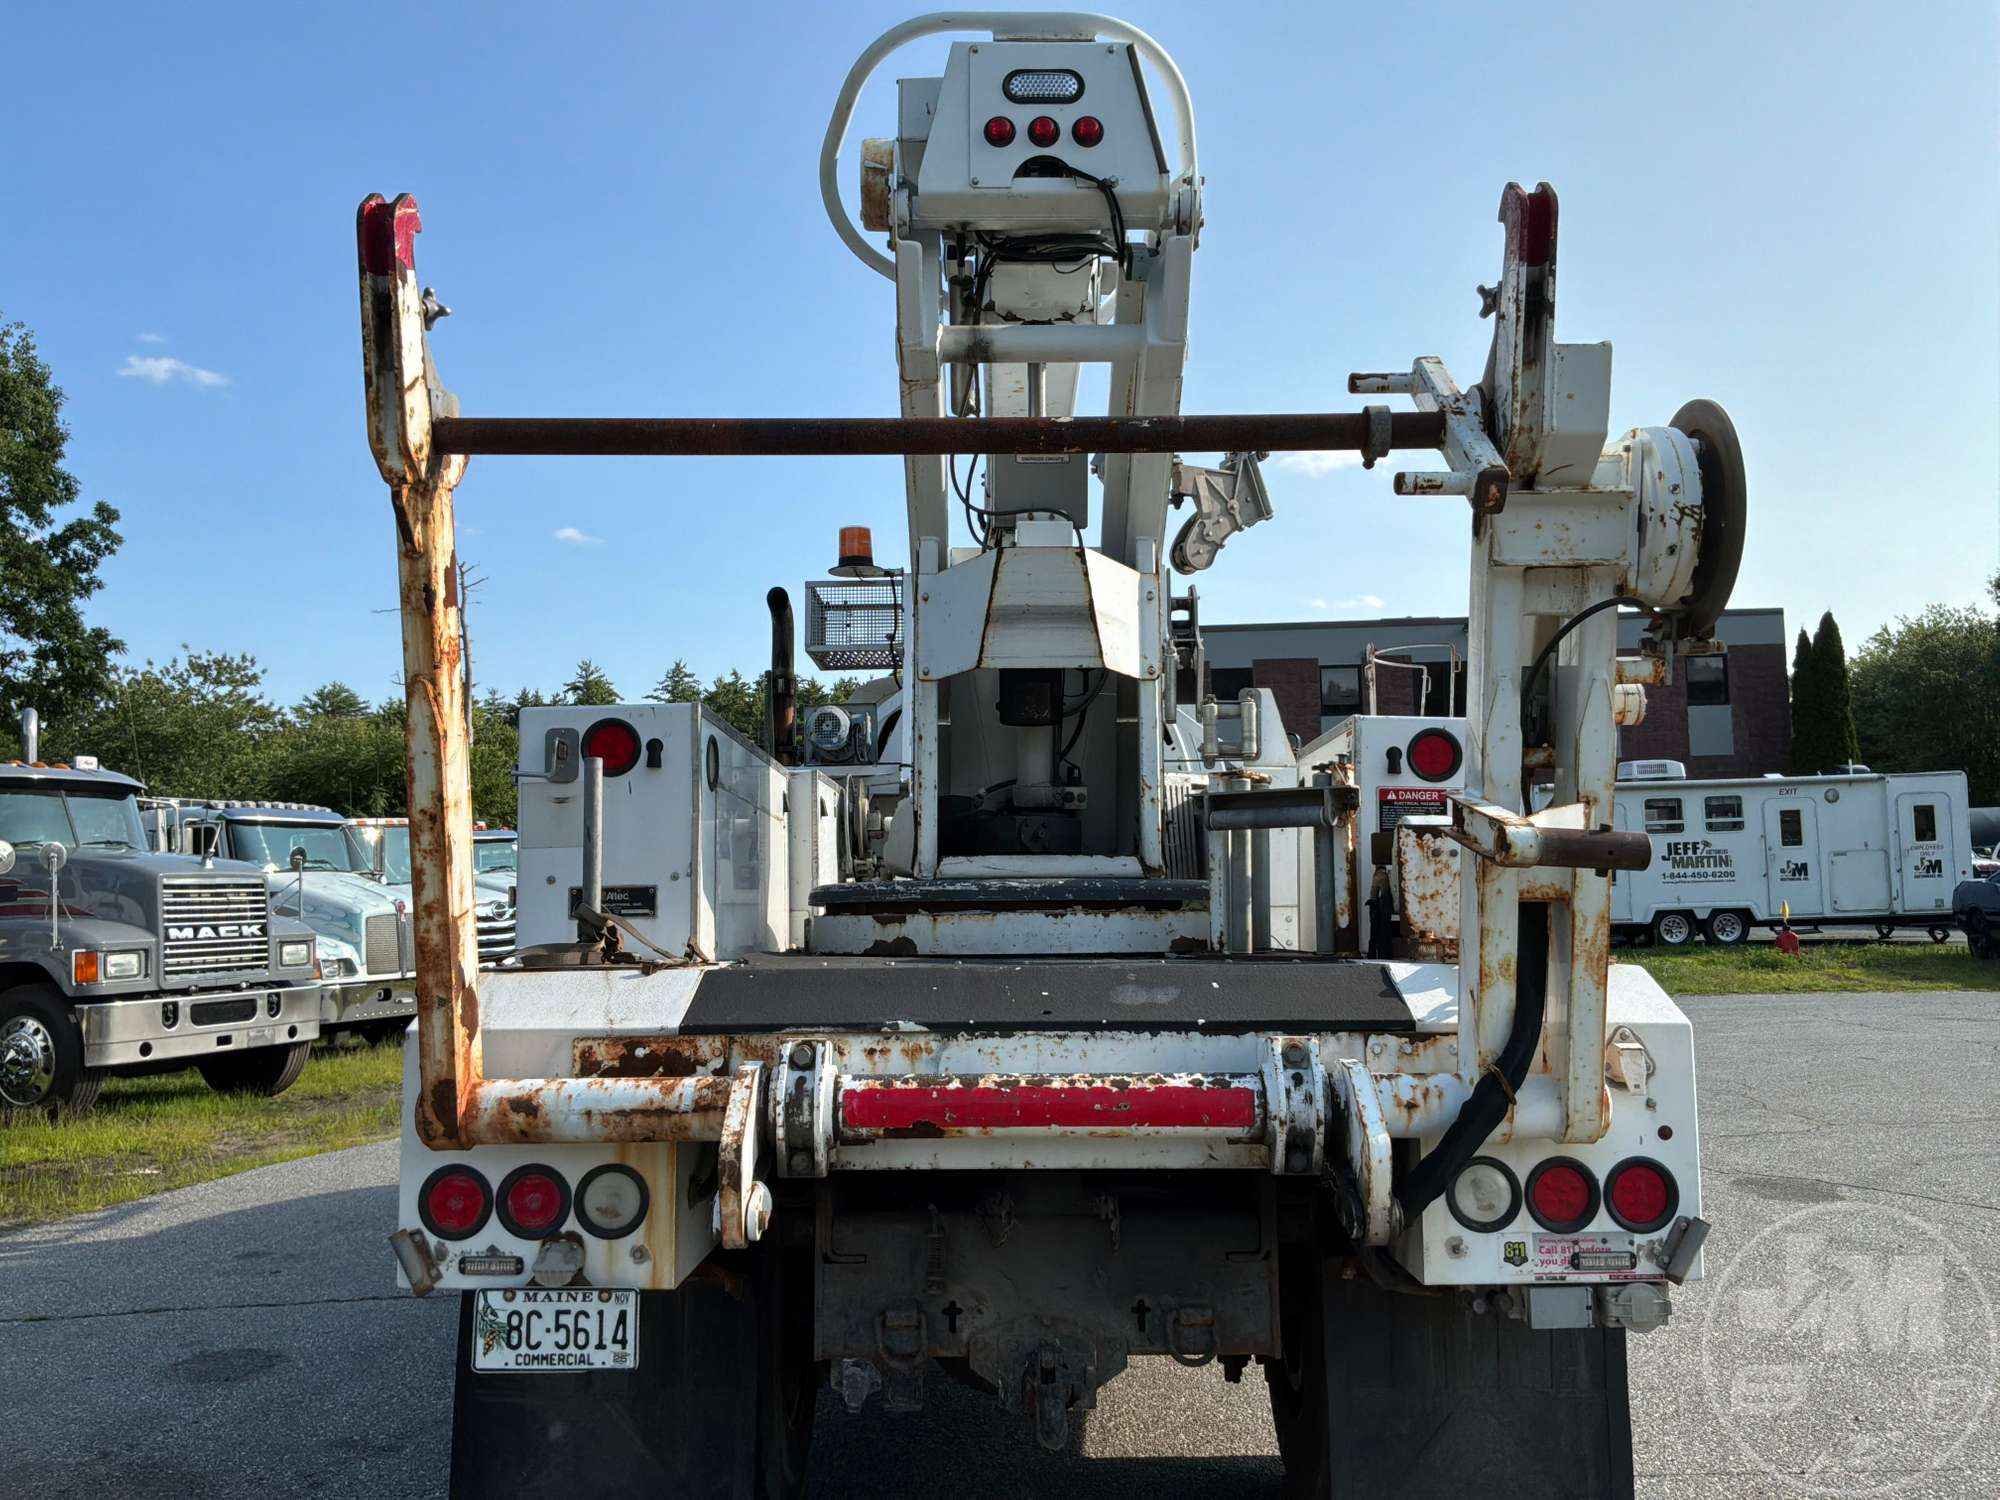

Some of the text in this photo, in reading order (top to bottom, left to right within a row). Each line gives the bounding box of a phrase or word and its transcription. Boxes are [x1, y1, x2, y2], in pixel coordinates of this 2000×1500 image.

[1398, 791, 1439, 800] DANGER
[1779, 788, 1799, 796] EXIT
[1661, 842, 1701, 861] JEFF
[1671, 855, 1729, 870] MARTIN
[1662, 870, 1736, 880] 1-844-450-6200
[168, 924, 263, 940] MACK
[1503, 1240, 1526, 1257] 811
[1539, 1245, 1558, 1254] Call
[1540, 1255, 1573, 1266] you di
[522, 1291, 594, 1303] MAINE
[614, 1293, 630, 1304] NOV
[515, 1353, 594, 1366] COMMERCIAL
